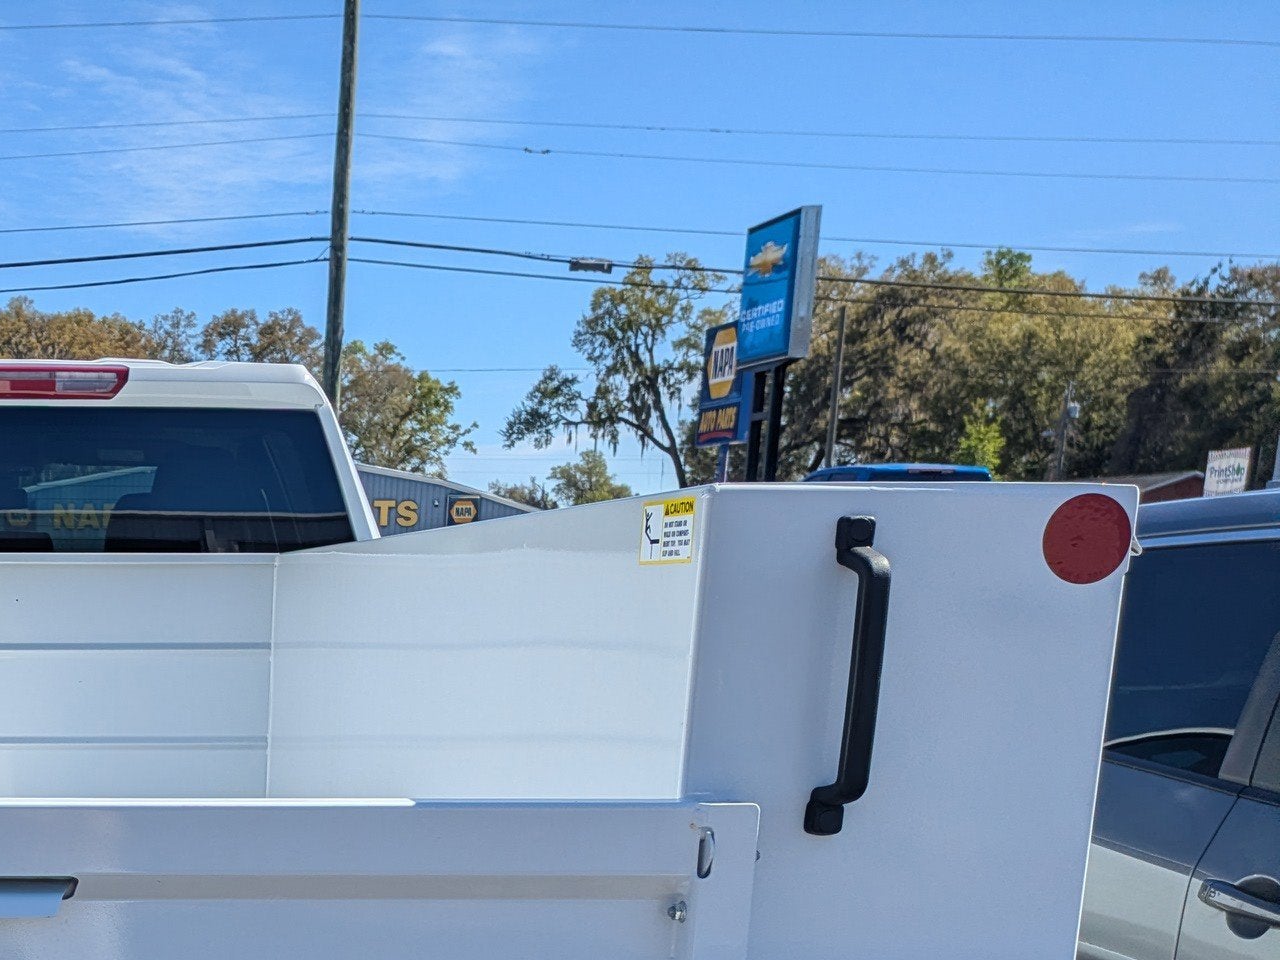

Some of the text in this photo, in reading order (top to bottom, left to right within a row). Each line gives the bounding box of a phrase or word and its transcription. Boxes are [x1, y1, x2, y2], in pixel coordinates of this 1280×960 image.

[741, 300, 784, 322] CERTIFIED
[712, 346, 735, 380] NAPA
[455, 507, 472, 517] NAPA
[670, 500, 694, 514] CAUTION
